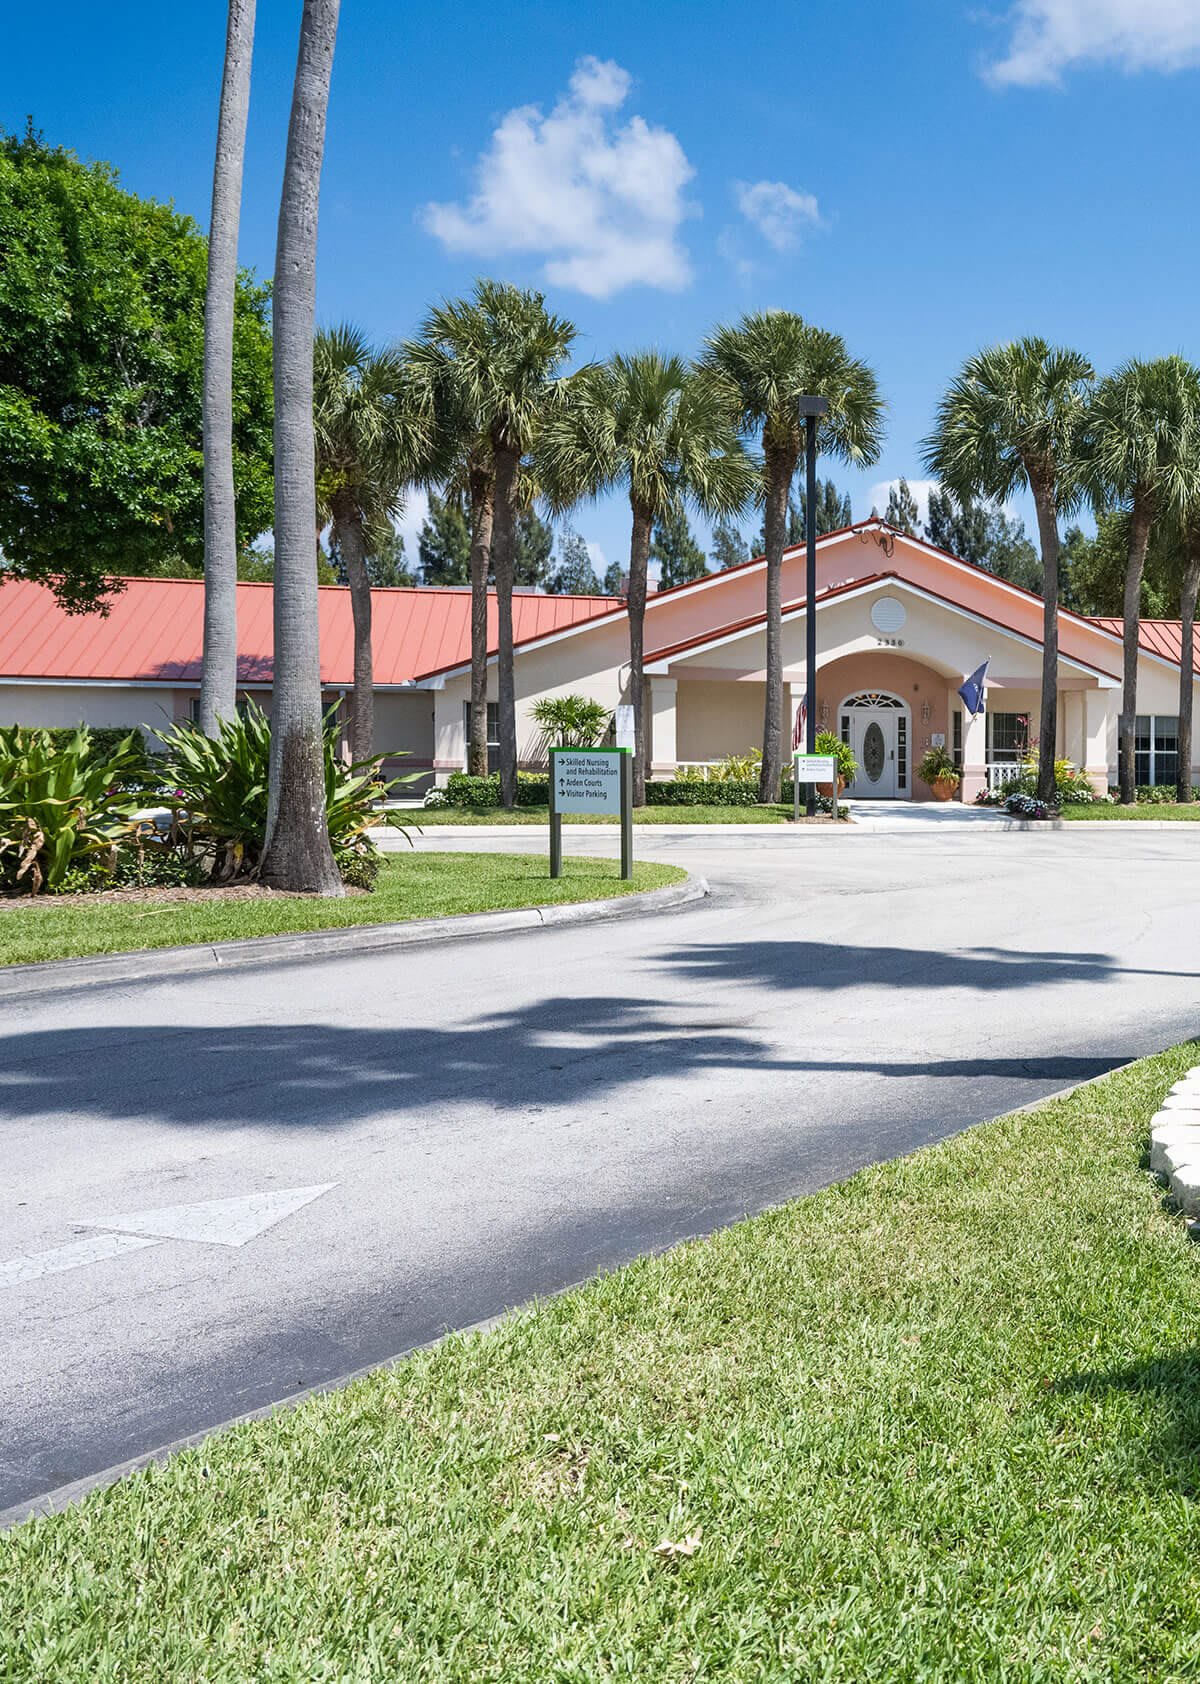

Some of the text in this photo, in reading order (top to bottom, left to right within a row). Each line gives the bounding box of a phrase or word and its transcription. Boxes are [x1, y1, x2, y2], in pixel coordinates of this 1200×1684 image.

[566, 758, 609, 768] Skilled Nursing
[578, 767, 618, 776] Rehabilitation
[566, 789, 607, 800] Visitor Parking
